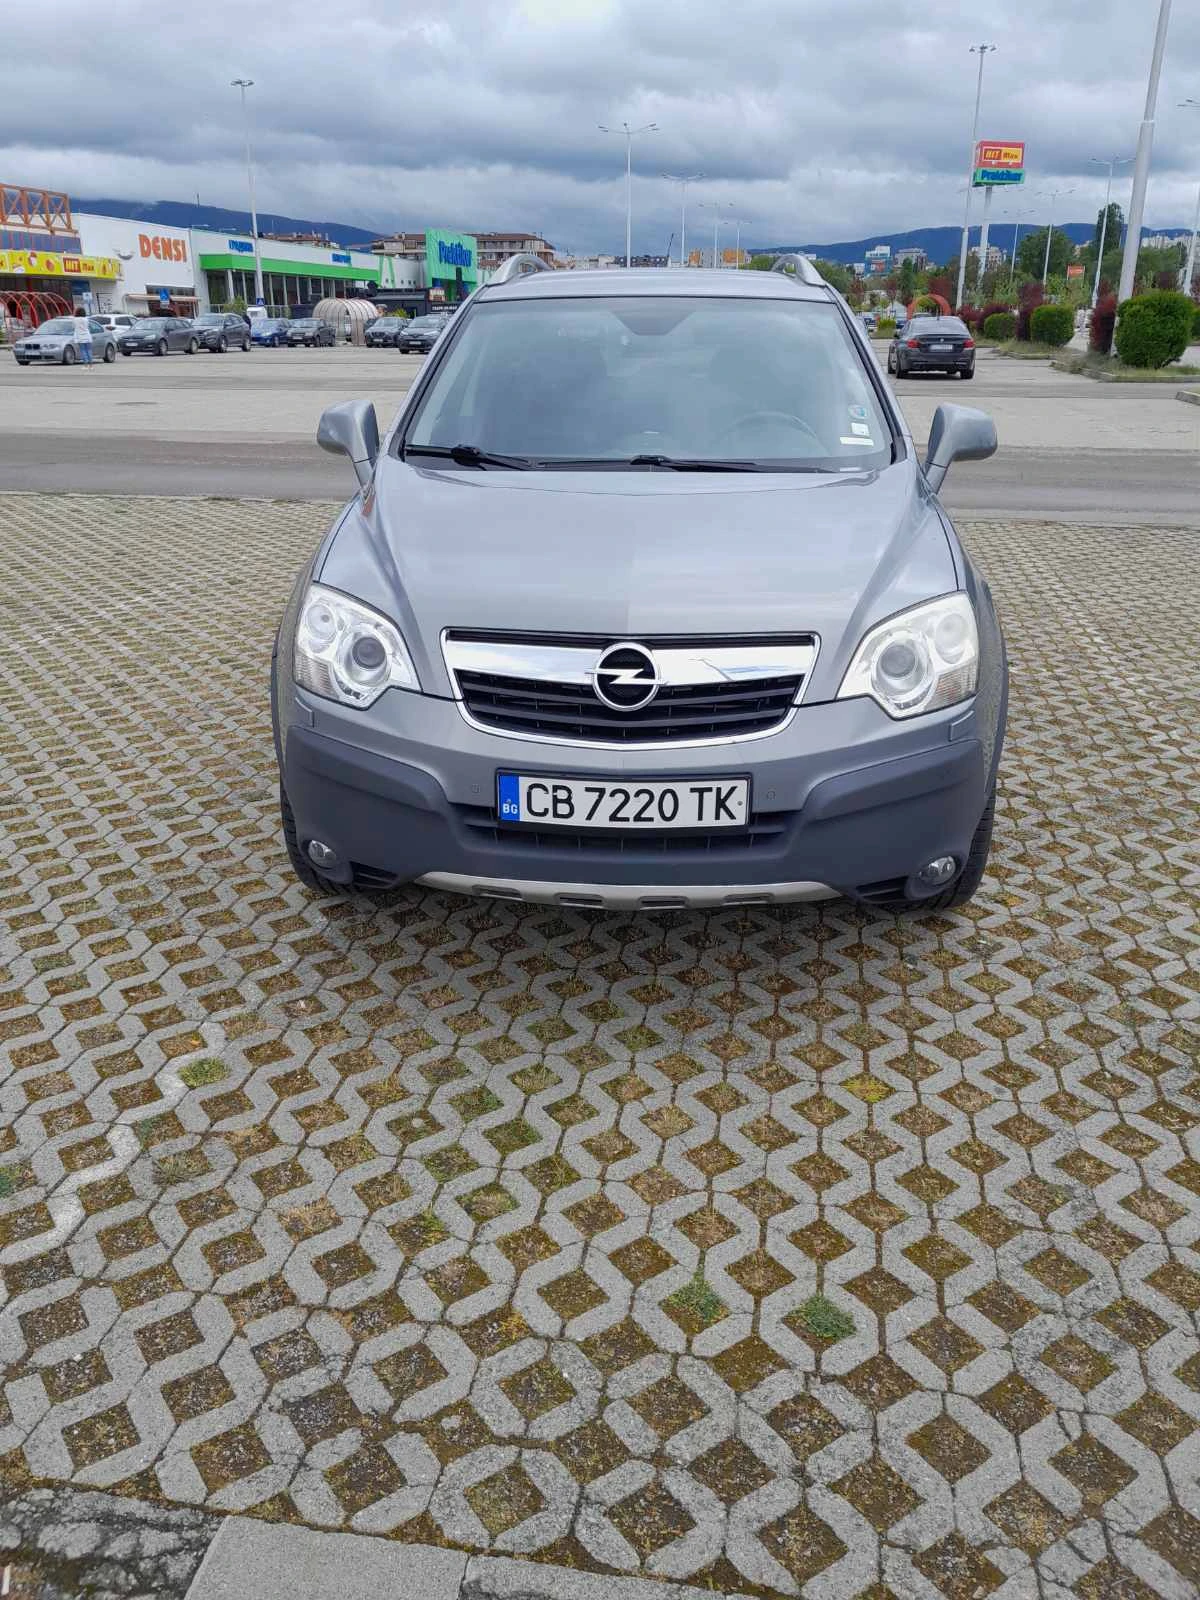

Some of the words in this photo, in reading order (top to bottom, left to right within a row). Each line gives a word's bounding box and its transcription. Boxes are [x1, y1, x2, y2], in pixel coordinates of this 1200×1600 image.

[138, 234, 187, 262] DENSI
[502, 803, 518, 815] BG
[526, 782, 575, 819] CB
[584, 786, 680, 823] 7220
[689, 785, 739, 822] TK
